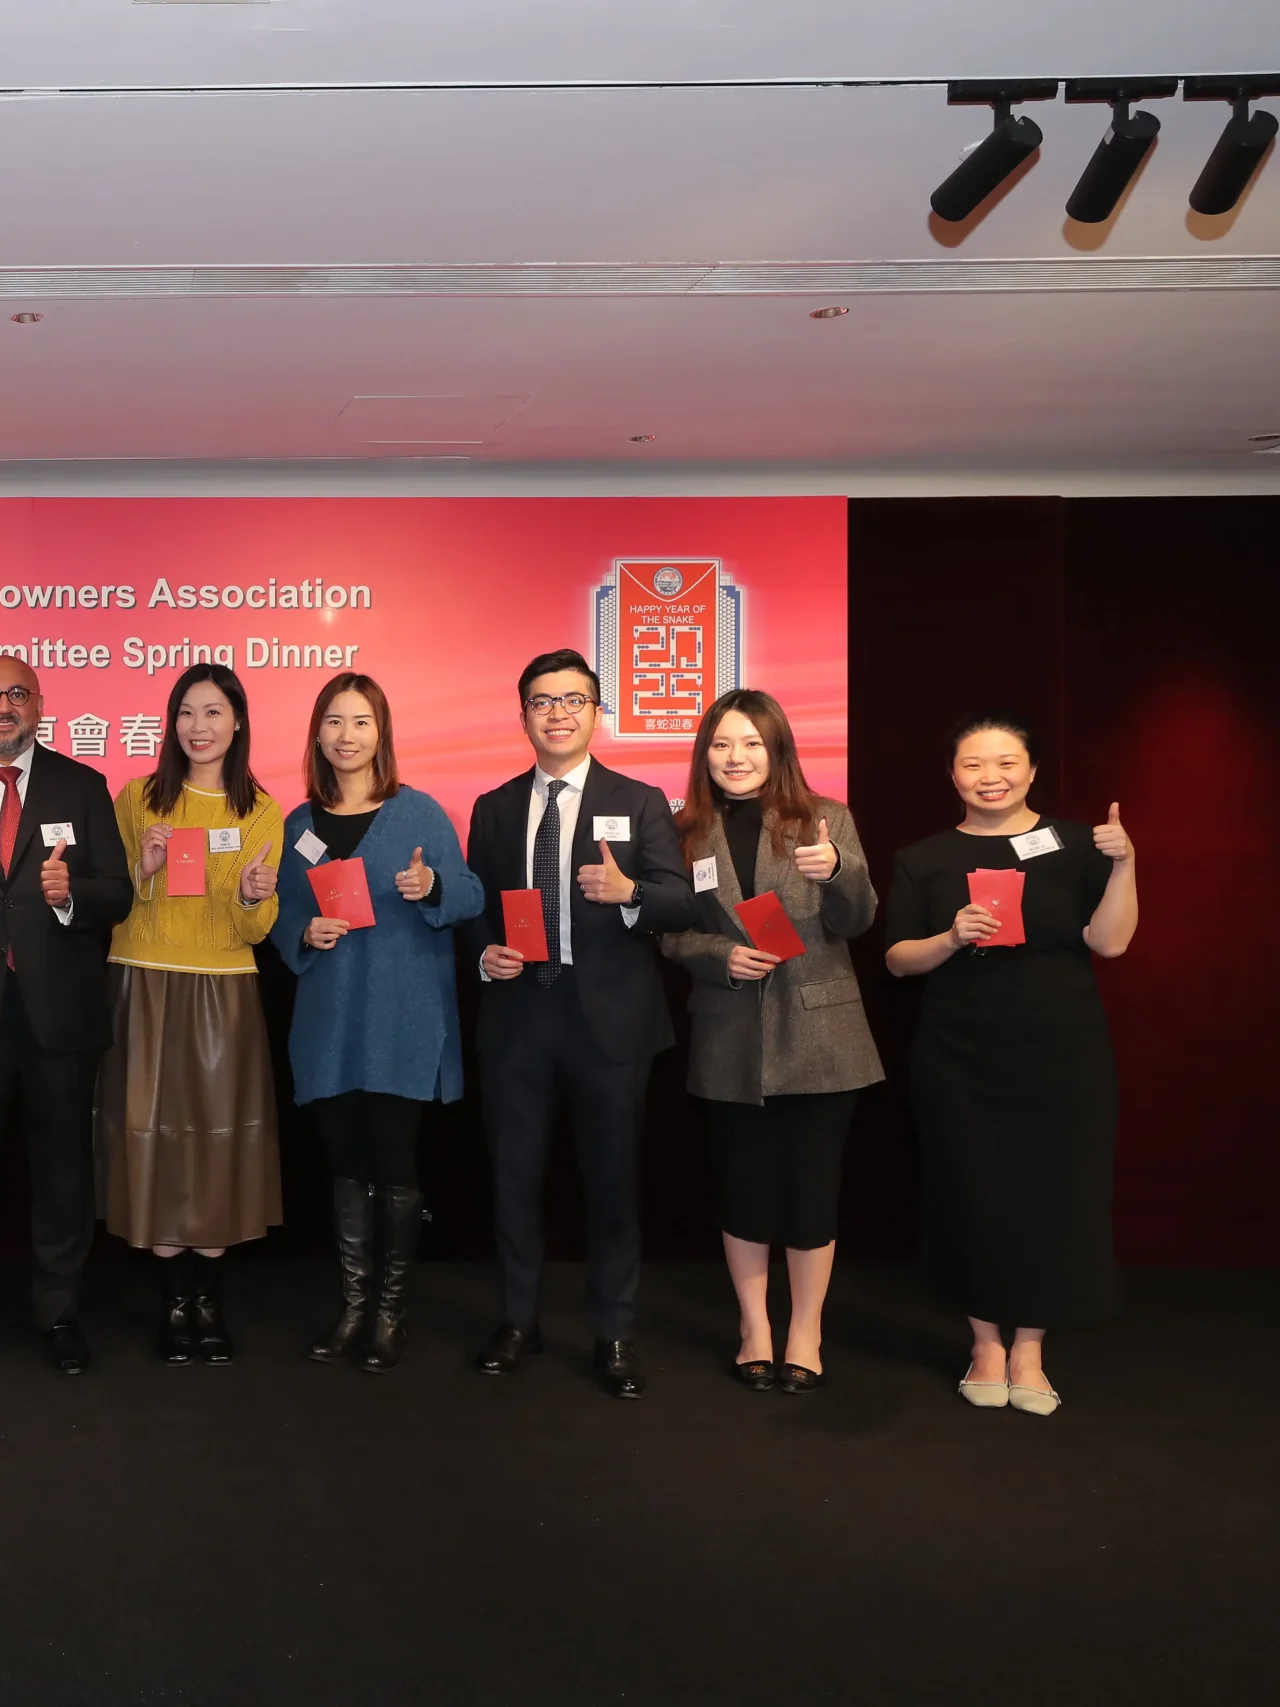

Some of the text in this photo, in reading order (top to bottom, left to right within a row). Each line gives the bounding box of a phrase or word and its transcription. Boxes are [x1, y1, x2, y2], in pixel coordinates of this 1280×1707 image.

[147, 577, 371, 608] Association
[629, 605, 706, 614] HAPPY YEAR OF
[641, 615, 695, 624] THE SNAKE
[122, 637, 234, 676] Spring
[245, 637, 359, 669] Dinner
[644, 718, 694, 731] 喜蛇迎春
